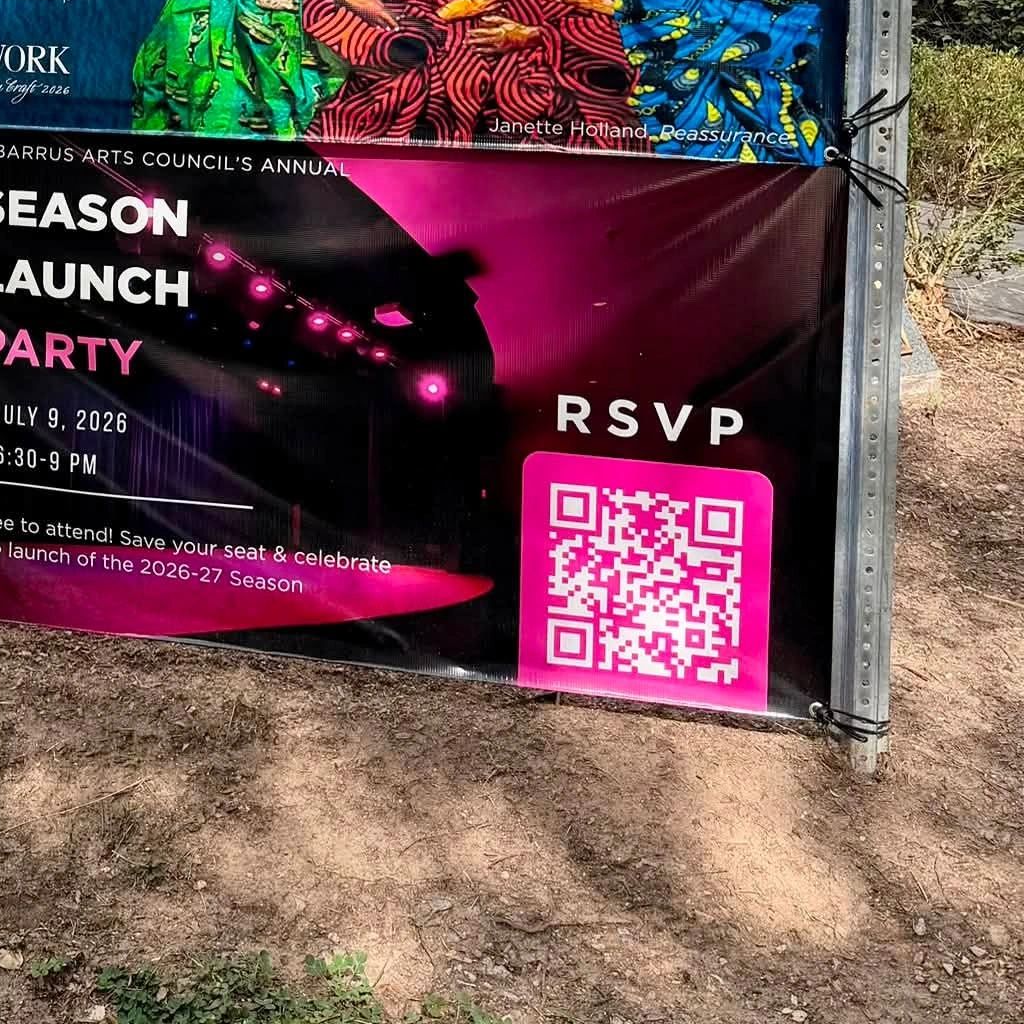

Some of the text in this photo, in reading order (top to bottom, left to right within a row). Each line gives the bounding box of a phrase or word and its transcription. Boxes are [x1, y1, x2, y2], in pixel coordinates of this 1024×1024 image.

[5, 78, 42, 104] Craft
[41, 83, 71, 95] 2026
[489, 117, 564, 136] Janette
[659, 123, 792, 146] Reassurance
[81, 147, 135, 167] ARTS
[260, 157, 352, 177] ANNUAL
[48, 406, 66, 432] 9,
[76, 408, 128, 434] 2026
[556, 393, 744, 446] RSVP
[70, 452, 97, 475] PM
[20, 515, 40, 535] to
[45, 519, 114, 544] attend!
[120, 529, 166, 551] Save
[172, 538, 217, 559] your
[223, 542, 267, 562] seat
[272, 544, 288, 563] &
[293, 546, 392, 575] celebrate
[8, 541, 71, 566] launch
[76, 549, 97, 569] of
[102, 553, 134, 574] the
[140, 559, 222, 584] 2026-27
[229, 570, 304, 594] Season
